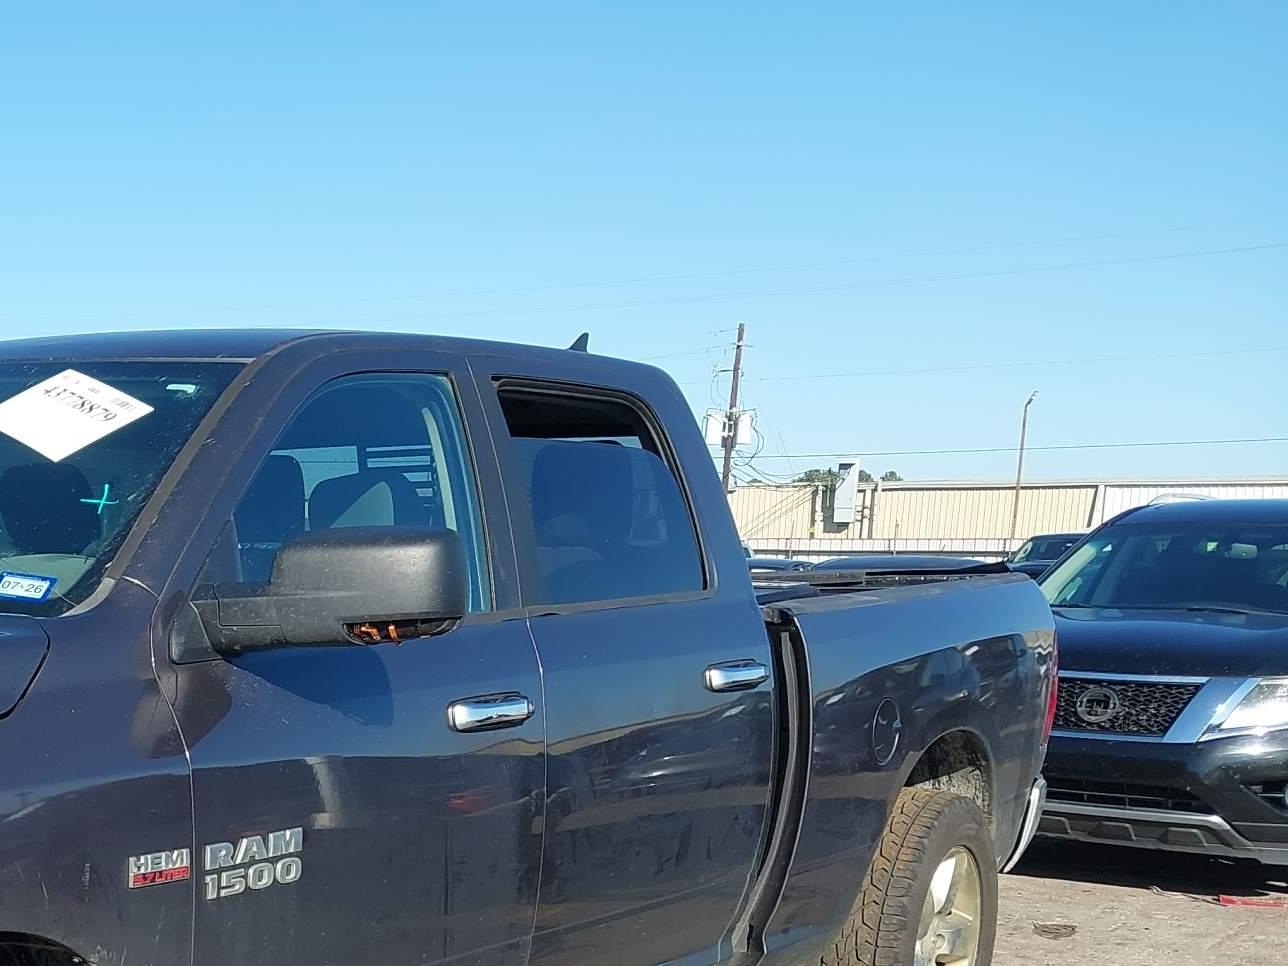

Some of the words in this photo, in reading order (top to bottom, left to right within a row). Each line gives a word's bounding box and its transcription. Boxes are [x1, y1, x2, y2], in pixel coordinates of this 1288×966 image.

[42, 385, 118, 421] 43778879
[128, 848, 190, 873] HEMI
[204, 827, 303, 870] RAM
[205, 857, 302, 900] 1500
